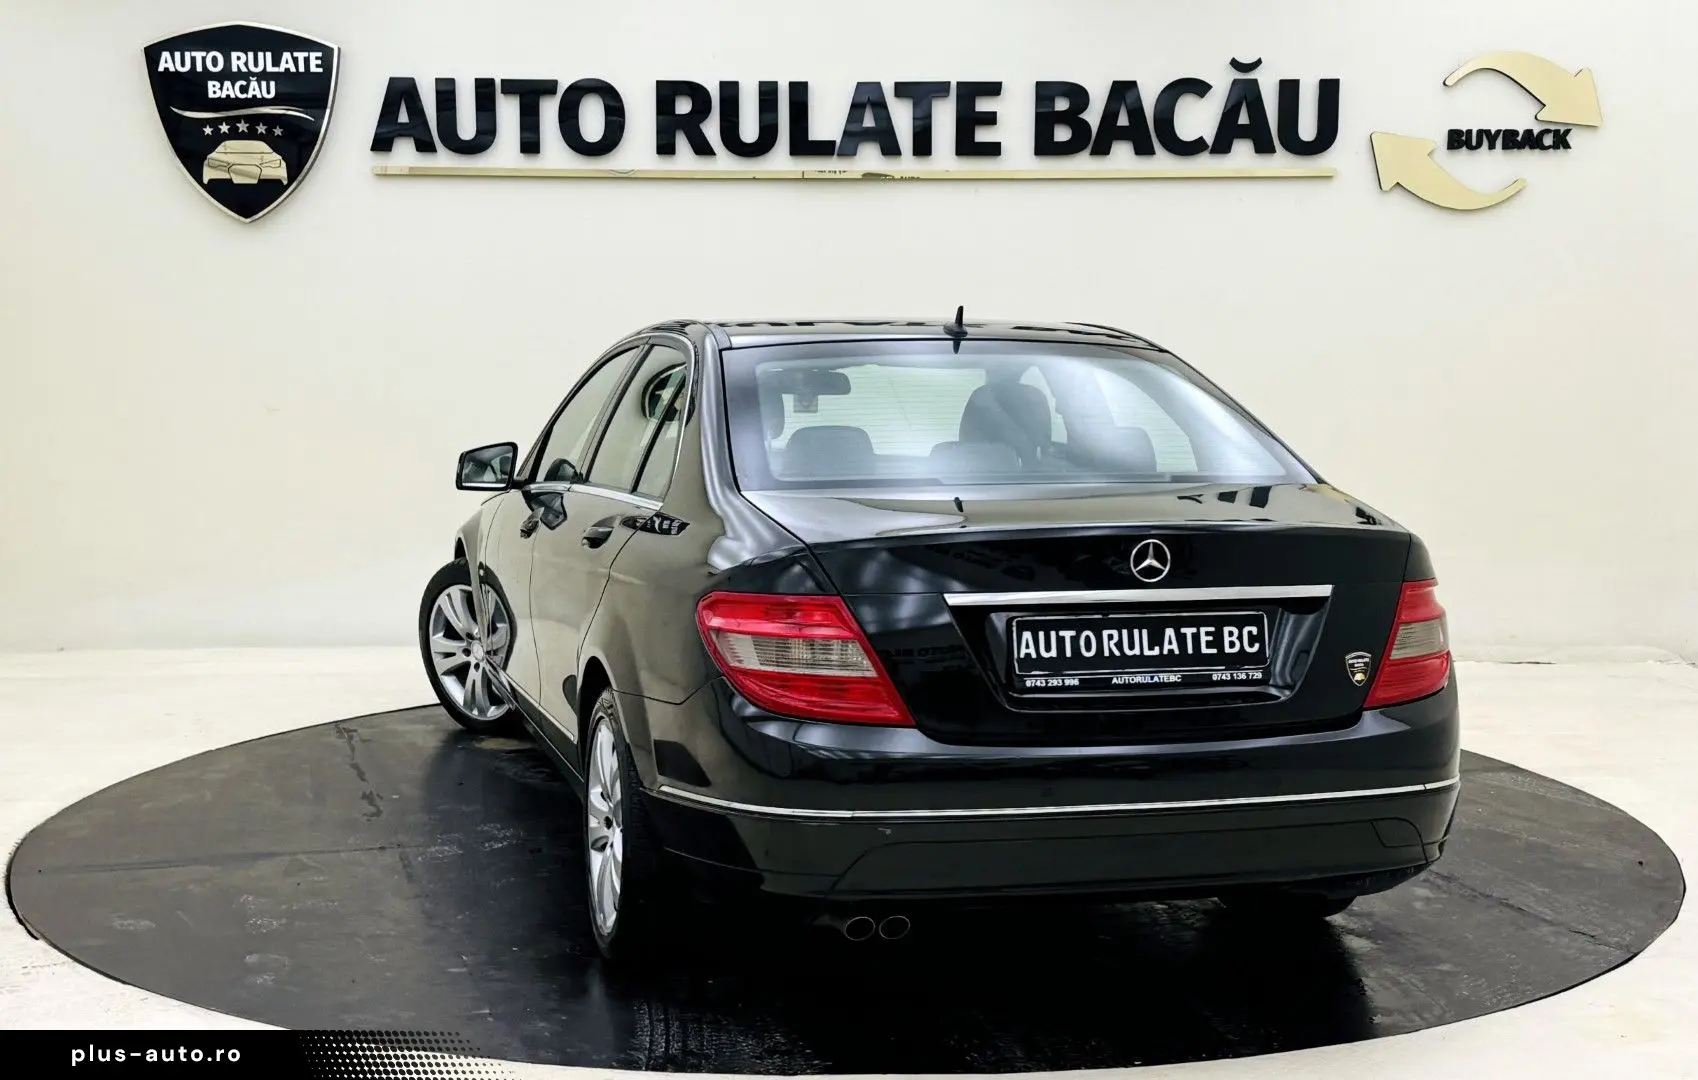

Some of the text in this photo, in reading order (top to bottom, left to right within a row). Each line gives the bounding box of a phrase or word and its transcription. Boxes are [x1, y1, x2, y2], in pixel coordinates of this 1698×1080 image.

[158, 51, 324, 73] AUTO RULATE
[207, 76, 276, 99] BACĂU
[370, 56, 1341, 158] AUTO RULATE BACĂU
[1446, 128, 1572, 151] BUYBACK
[1019, 625, 1260, 659] AUTO RULATE BC
[1025, 679, 1046, 688] 0743
[1047, 678, 1063, 687] 293
[1111, 674, 1182, 685] AUTORULATEBC
[1211, 671, 1263, 681] 0743 136 729
